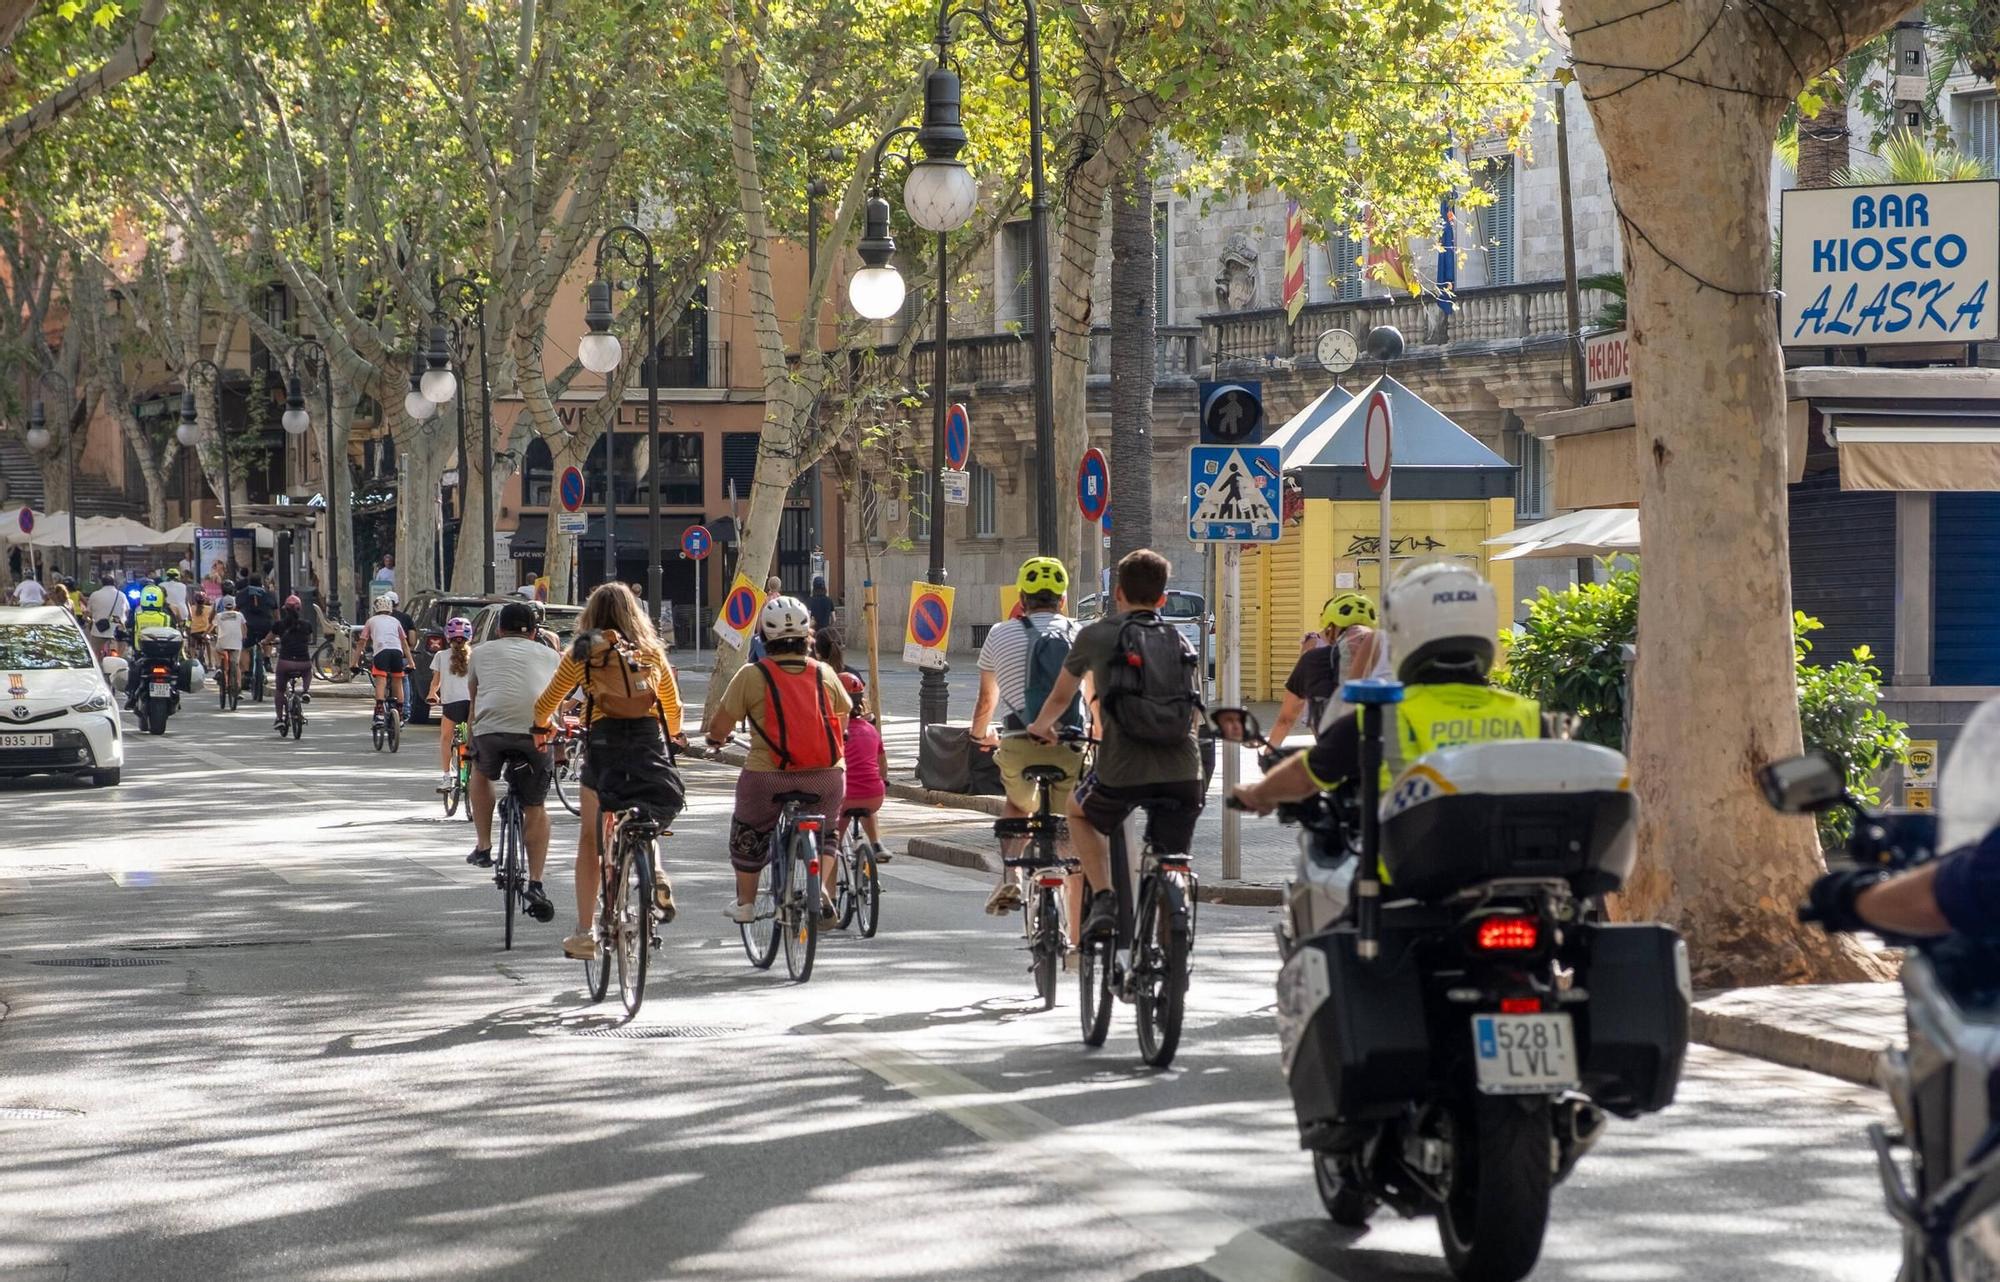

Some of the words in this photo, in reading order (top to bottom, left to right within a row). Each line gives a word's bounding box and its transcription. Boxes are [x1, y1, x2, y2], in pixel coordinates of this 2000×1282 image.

[1852, 193, 1929, 229] BAR
[1813, 234, 1968, 273] KIOSCO
[1793, 279, 1989, 338] ALASKA
[1588, 339, 1629, 382] HELADE
[1433, 590, 1477, 604] POLICIA
[31, 735, 52, 746] JTJ
[1431, 718, 1525, 740] POLICIA
[1497, 1022, 1562, 1050] 5281
[1506, 1050, 1559, 1077] LVL
